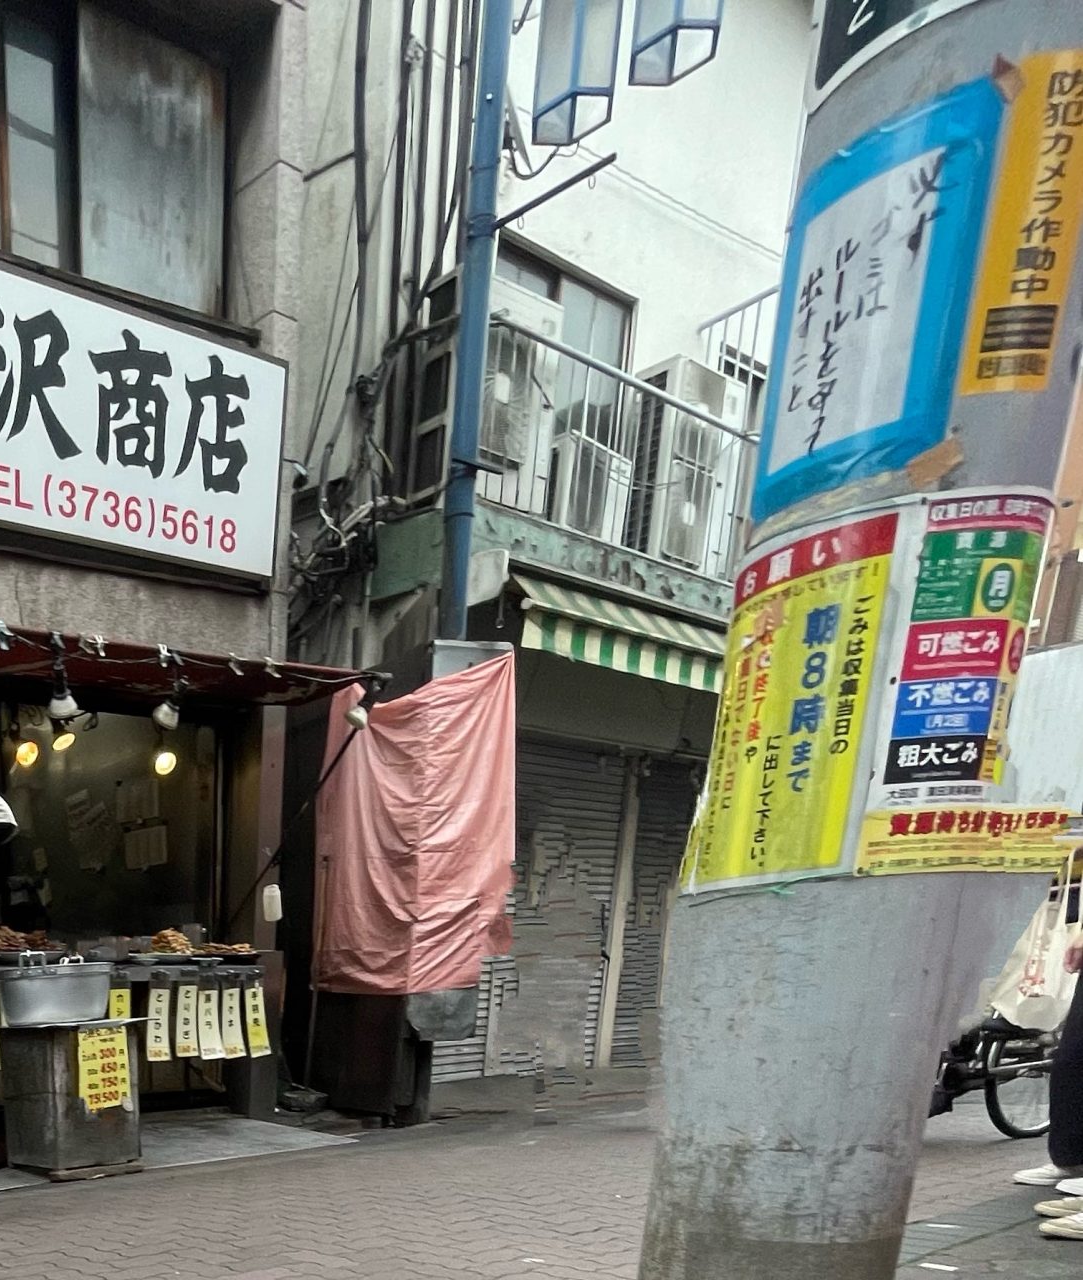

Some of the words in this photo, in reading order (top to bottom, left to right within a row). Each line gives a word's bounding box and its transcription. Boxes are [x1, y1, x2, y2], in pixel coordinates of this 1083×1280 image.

[917, 630, 1001, 658] 可燃ごみ
[787, 603, 843, 793] 朝8時まで
[907, 681, 990, 708] 不燃ごみ
[896, 742, 979, 768] 粗大ごみ
